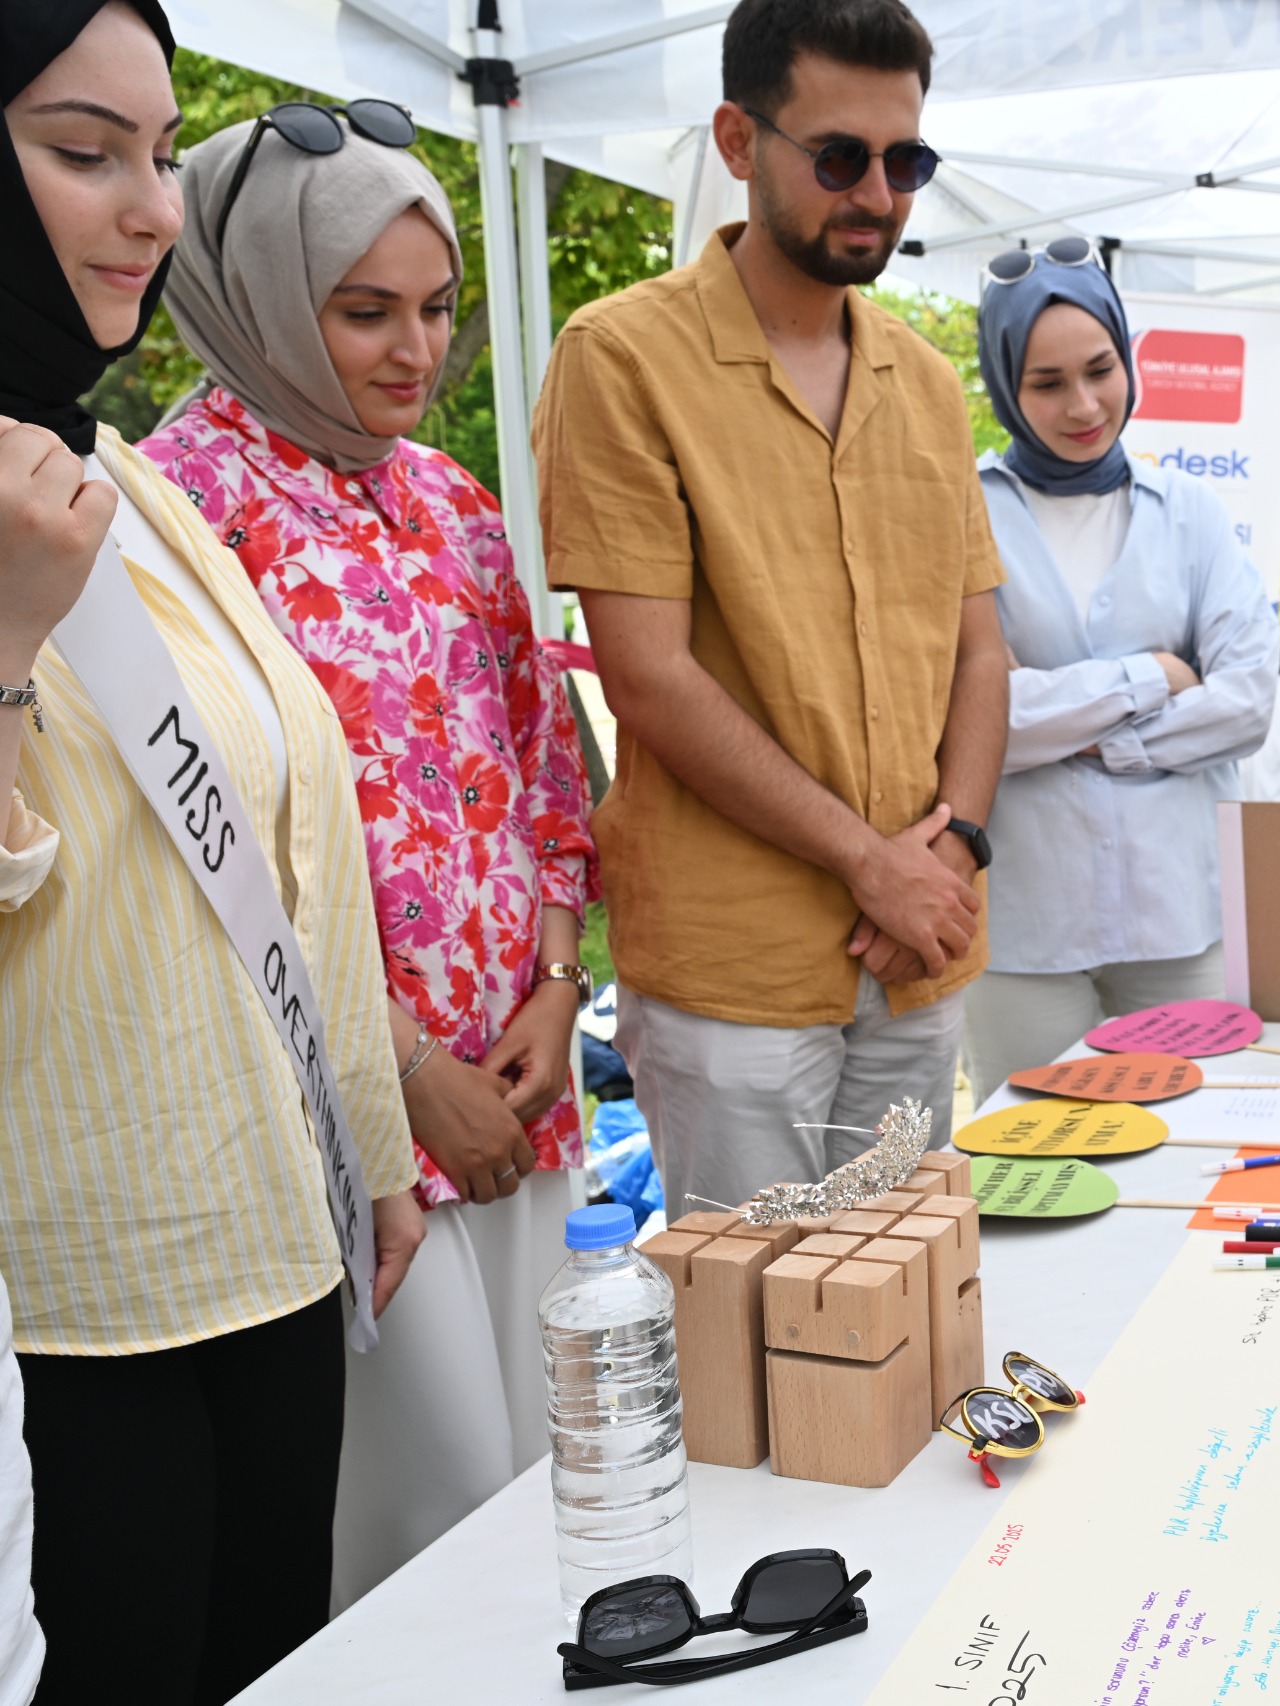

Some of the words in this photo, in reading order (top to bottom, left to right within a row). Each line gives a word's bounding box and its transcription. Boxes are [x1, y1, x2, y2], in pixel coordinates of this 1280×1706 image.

[147, 704, 236, 873] MISS
[992, 1118, 1042, 1146] İÇİNE
[988, 1524, 1024, 1566] 22.05.2025
[1162, 1517, 1190, 1537] PDR
[1145, 1655, 1162, 1670] der
[1166, 1612, 1180, 1630] sana
[1185, 1611, 1207, 1631] Emine
[955, 1614, 1001, 1671] SINIF
